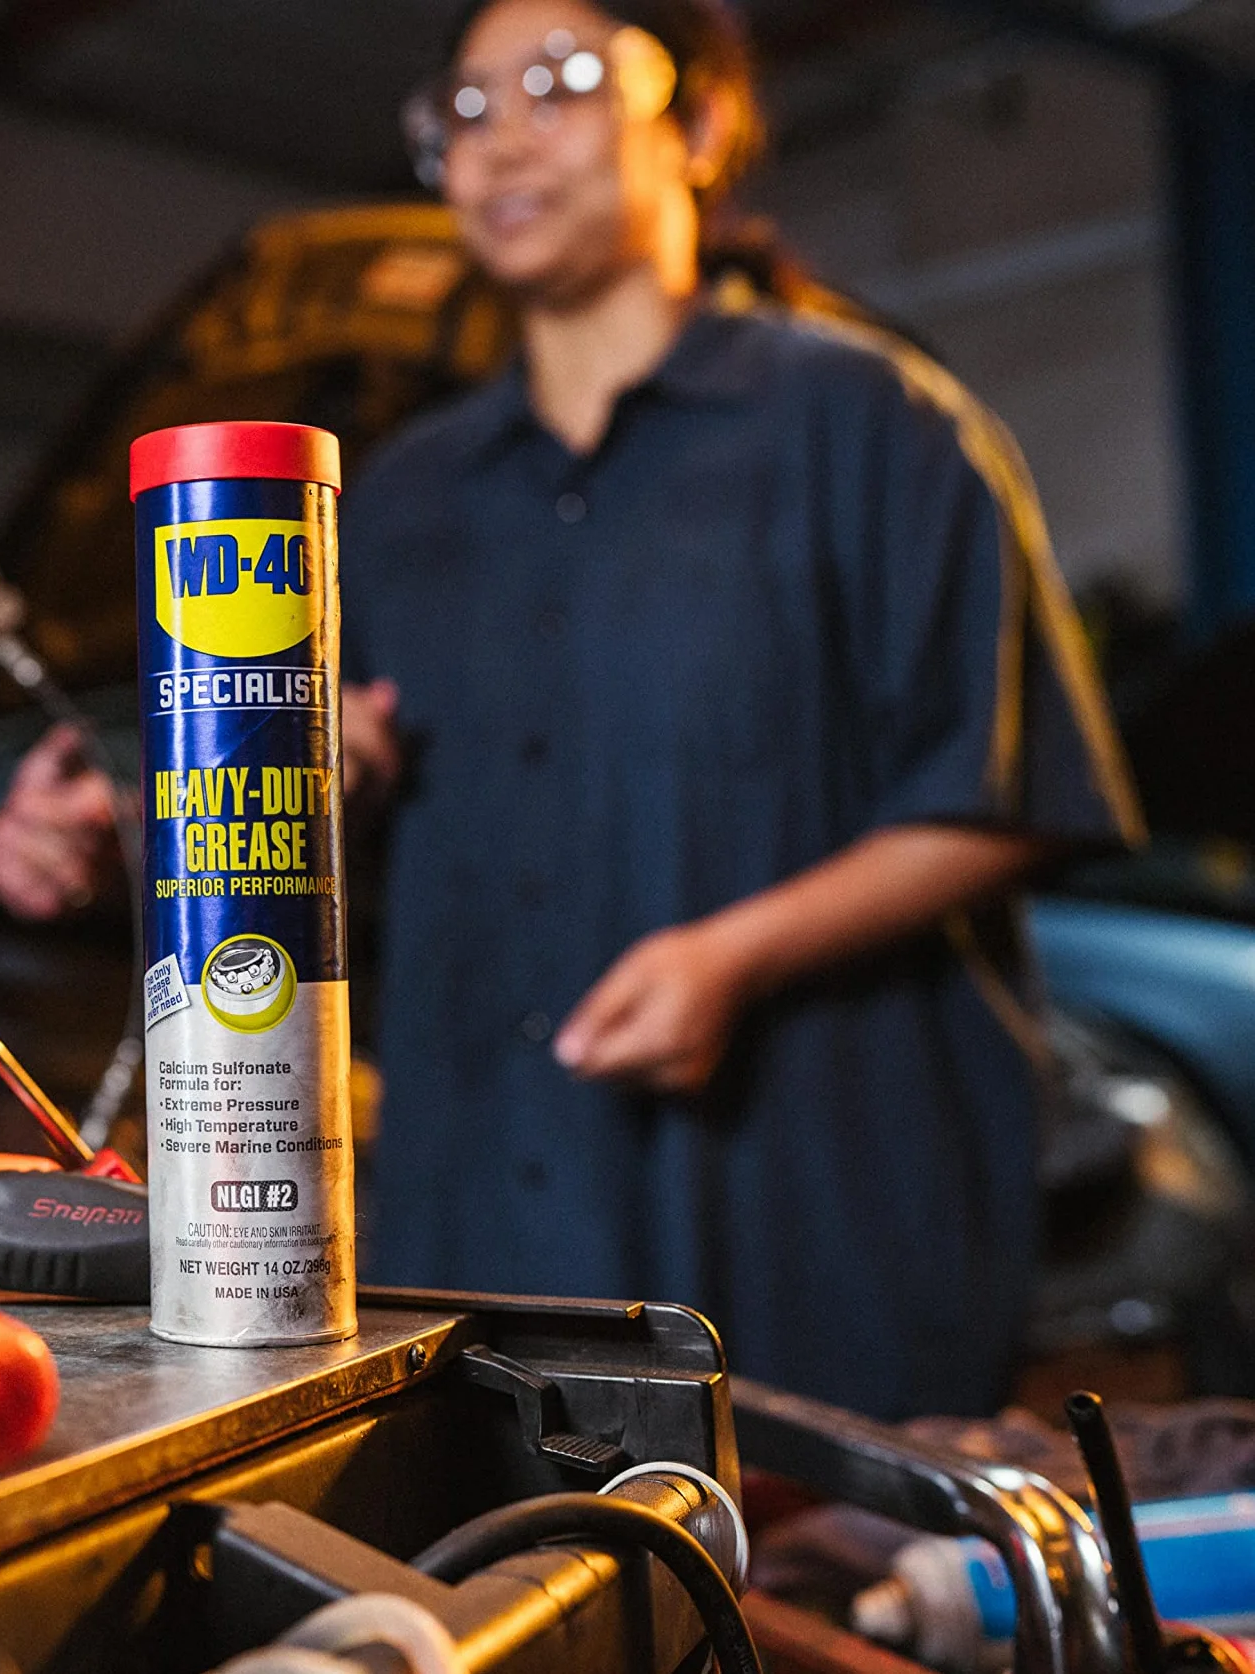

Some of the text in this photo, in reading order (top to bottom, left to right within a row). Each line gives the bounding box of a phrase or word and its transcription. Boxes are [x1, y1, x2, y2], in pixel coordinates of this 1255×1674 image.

[165, 533, 316, 599] WD-40
[159, 672, 324, 708] SPECIALIST
[155, 766, 333, 820] HEAVY-DUTY
[185, 821, 307, 873] GREASE
[155, 875, 337, 899] SUPERIOR PERFORMANCE
[154, 964, 171, 981] Only
[160, 991, 183, 1012] need
[159, 1061, 291, 1075] Calcium Sulfonate
[159, 1077, 242, 1091] Formula for:
[165, 1097, 300, 1112] Extreme Pressure
[165, 1118, 299, 1136] High Temperature
[165, 1136, 343, 1154] Severe Marine Conditions
[217, 1183, 292, 1208] NLGI #2
[188, 1222, 232, 1238] CAUTION:
[233, 1227, 249, 1238] EYE
[250, 1226, 267, 1238] AND
[269, 1226, 288, 1238] SKIN
[212, 1239, 229, 1248] other
[229, 1239, 263, 1250] cautionary
[264, 1238, 299, 1248] information
[179, 1259, 202, 1274] NET
[205, 1260, 260, 1276] WEIGHT
[263, 1262, 279, 1276] 14
[215, 1286, 299, 1299] MADE IN USA
